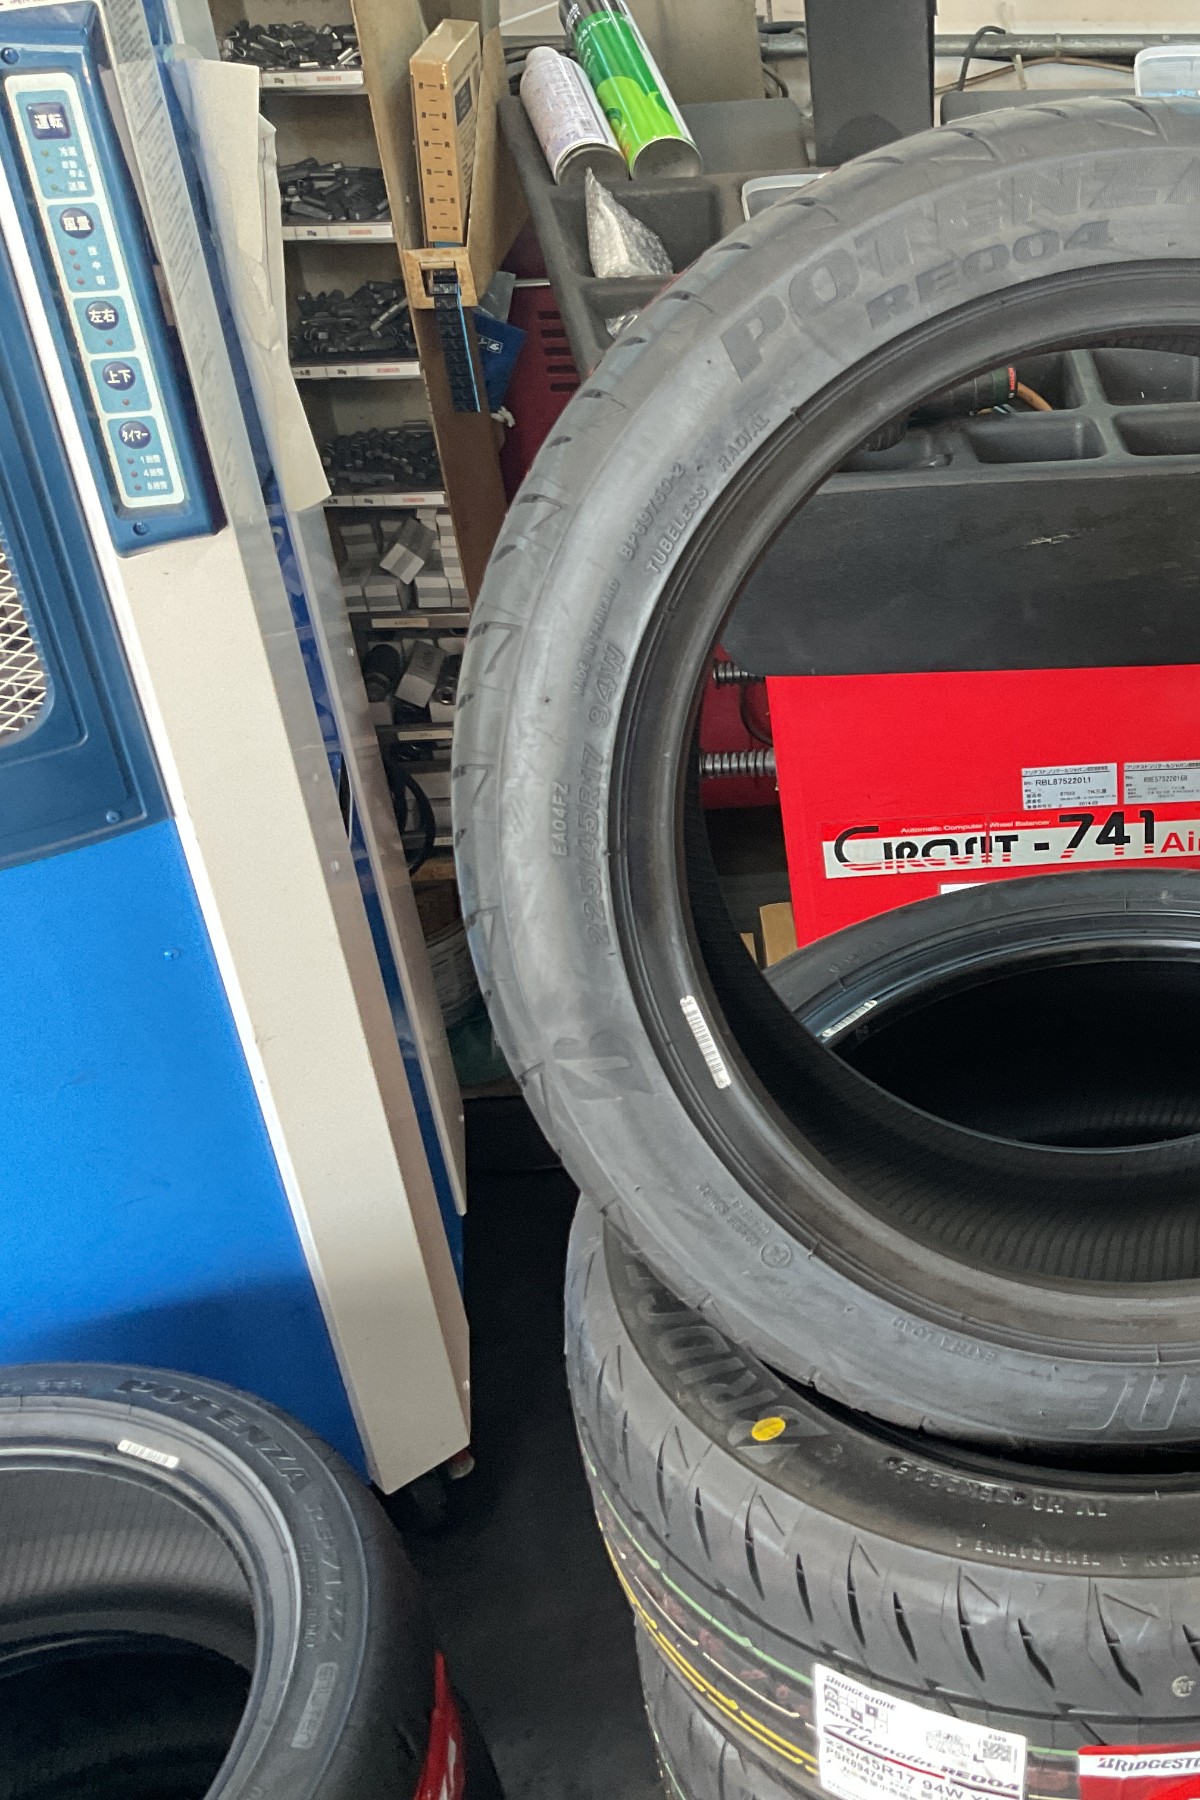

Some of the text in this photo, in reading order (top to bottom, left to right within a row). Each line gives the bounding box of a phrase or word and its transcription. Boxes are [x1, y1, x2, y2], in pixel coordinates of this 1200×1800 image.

[34, 114, 65, 131] 運転
[867, 218, 1112, 329] RE004
[88, 308, 116, 324] 左右
[107, 368, 132, 385] 上下
[121, 430, 149, 443] タイマー
[717, 413, 771, 474] RADIAL
[645, 484, 711, 577] TUBELESS
[588, 645, 626, 730] 94W
[901, 824, 943, 835] Automatic
[943, 821, 984, 833] Computer
[1015, 818, 1051, 829] Balancer
[1059, 809, 1155, 859] 741
[114, 1376, 313, 1495] POTENZA
[825, 1674, 897, 1711] BRIDGESTONE
[940, 1764, 1021, 1792] RE004
